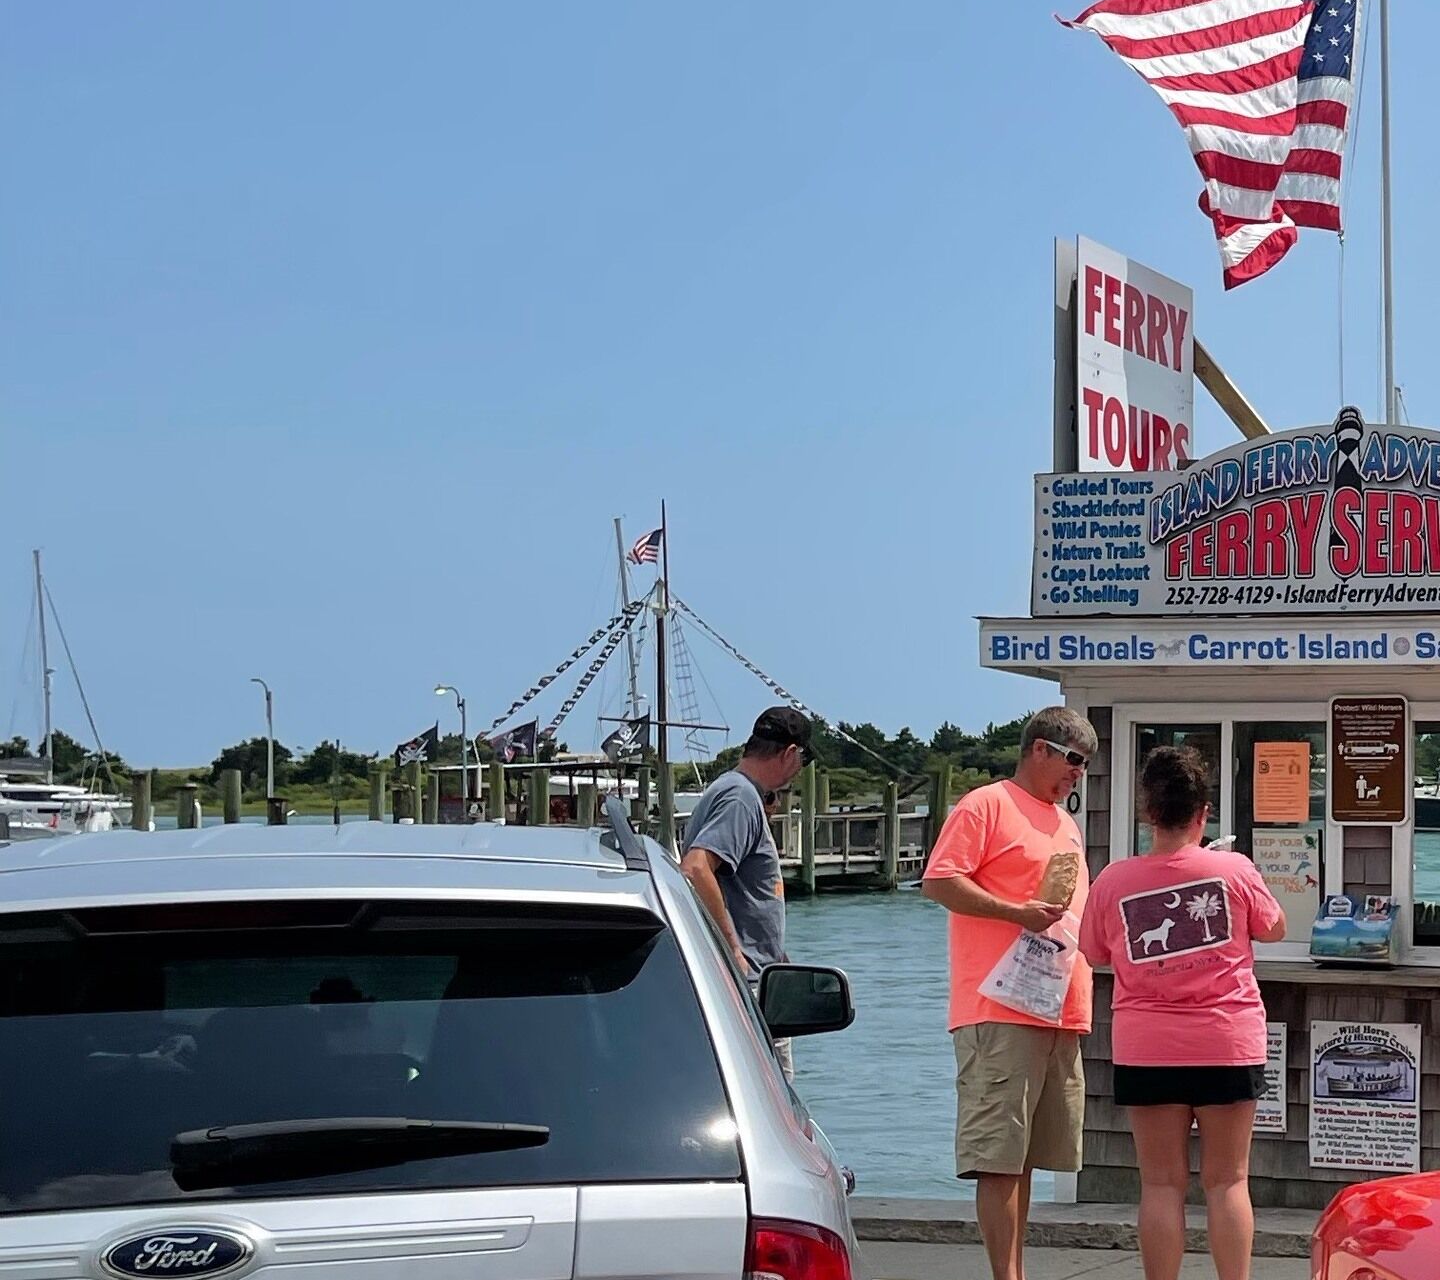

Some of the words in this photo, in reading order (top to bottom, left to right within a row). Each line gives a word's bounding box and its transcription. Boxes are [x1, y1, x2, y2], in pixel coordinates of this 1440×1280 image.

[1085, 265, 1188, 372] FERRY
[1083, 387, 1189, 471] TOURS
[1052, 478, 1107, 496] Guided
[1110, 478, 1153, 495] Tours
[1149, 458, 1242, 544] ISLAND
[1242, 433, 1337, 497] FERRY
[1052, 499, 1145, 518] Shackleford
[1052, 521, 1086, 539] Wild
[1090, 520, 1141, 539] Ponies
[1165, 490, 1328, 581] FERRY
[1052, 543, 1102, 561] Nature
[1105, 542, 1145, 559] Trails
[1051, 565, 1086, 586] Cape
[1089, 564, 1151, 581] Lookout
[1050, 587, 1070, 603] Go
[1073, 585, 1139, 606] Shelling
[1165, 585, 1274, 605] 252-728-4129
[991, 635, 1050, 660] Bird
[1058, 635, 1155, 661] Shoals
[1188, 634, 1289, 660] Carrot
[1299, 633, 1388, 659] Island
[1278, 838, 1303, 847] YOUR
[1260, 851, 1281, 860] MAP
[1289, 851, 1309, 860] THIS
[1265, 864, 1290, 872] YOUR
[1339, 1025, 1360, 1035] Wild
[1363, 1025, 1390, 1038] Horse
[1314, 1036, 1342, 1056] Nature
[1354, 1034, 1388, 1046] History
[1389, 1037, 1416, 1063] Cruise
[134, 1236, 218, 1270] Ford
